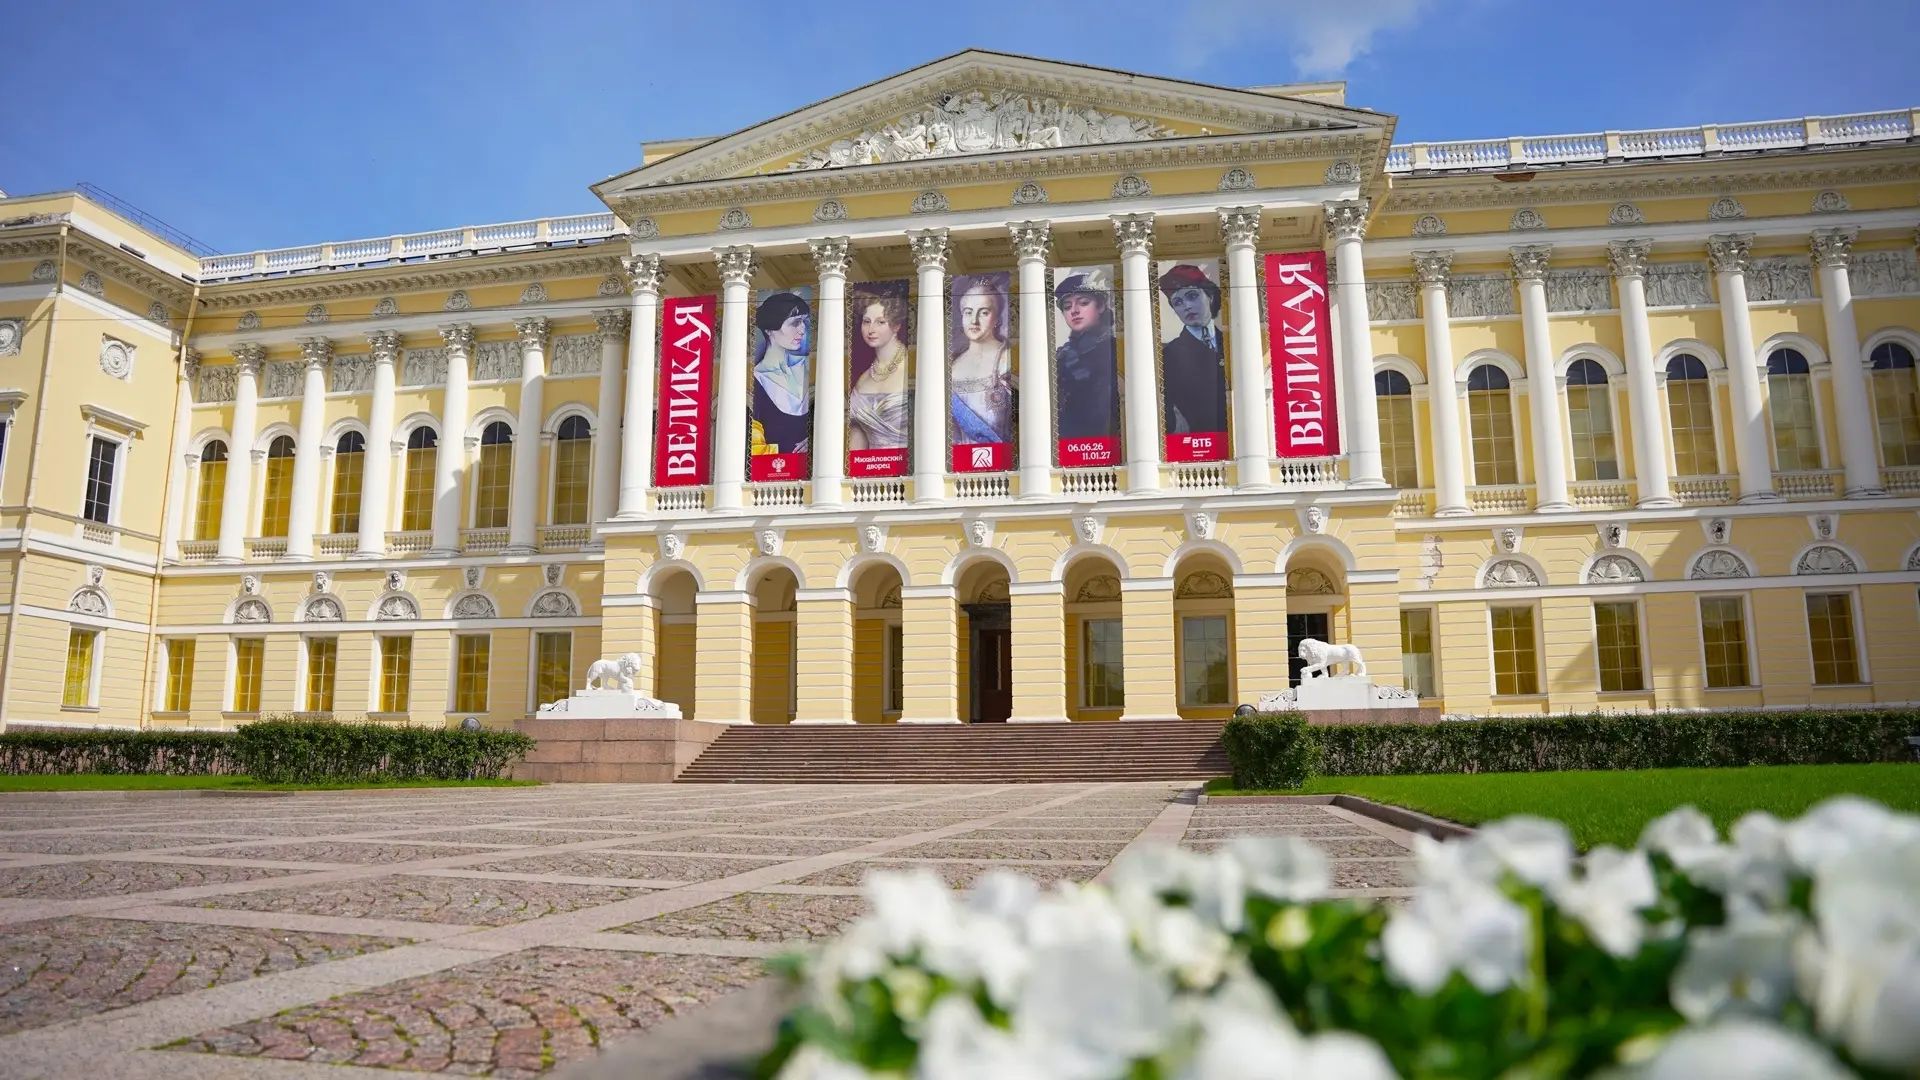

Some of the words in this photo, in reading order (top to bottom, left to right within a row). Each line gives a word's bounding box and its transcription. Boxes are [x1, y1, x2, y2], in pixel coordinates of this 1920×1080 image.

[1278, 261, 1325, 447] ВЕЛИКАЯ
[667, 303, 711, 477] ВЕЛИКАЯ
[1067, 442, 1104, 452] 06.06.26
[1192, 438, 1212, 448] ВТБ
[854, 454, 903, 463] Михайловский
[1082, 451, 1110, 460] 11.01.27
[866, 463, 890, 471] дворец
